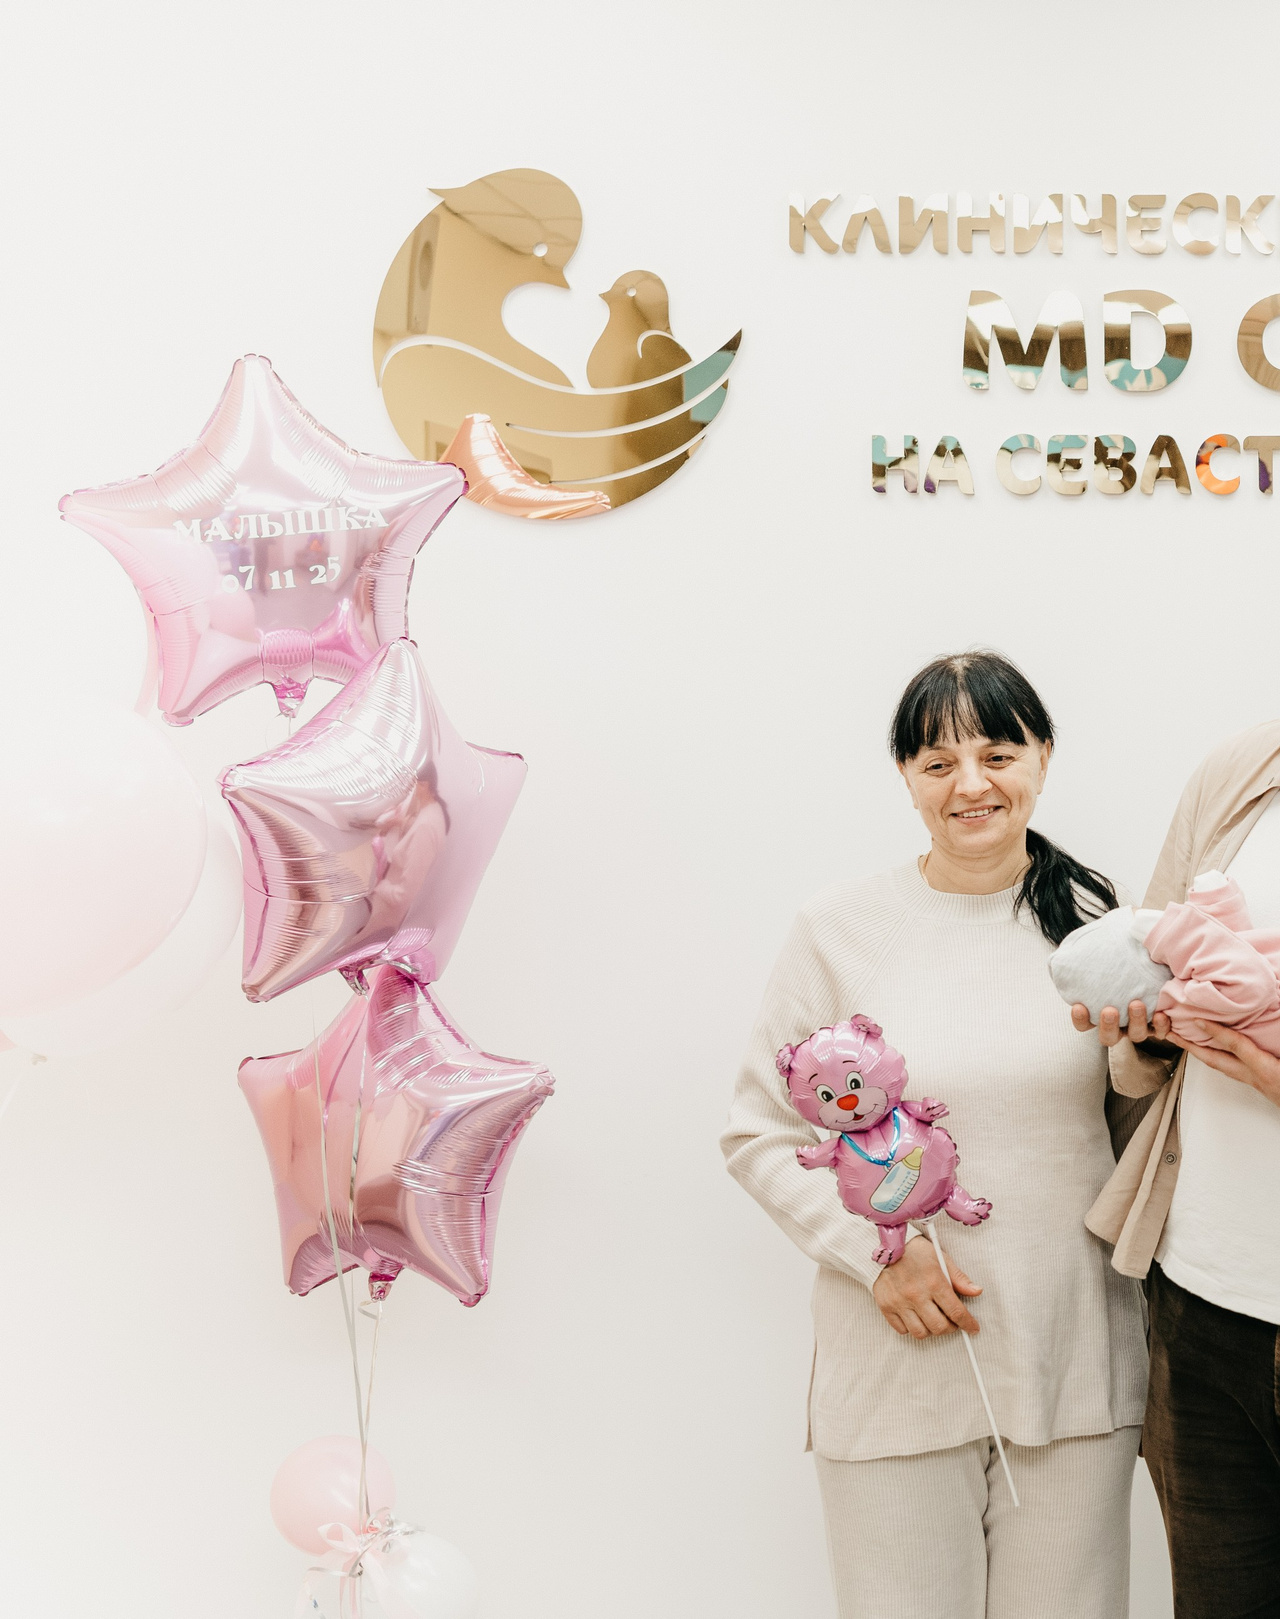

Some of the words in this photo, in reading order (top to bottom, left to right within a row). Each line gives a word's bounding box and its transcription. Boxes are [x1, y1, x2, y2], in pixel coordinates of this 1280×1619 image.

[961, 289, 1193, 392] MD
[871, 433, 974, 496] НА
[172, 505, 390, 545] МАЛЫШКА
[221, 565, 256, 594] 07
[269, 569, 297, 590] 11
[308, 556, 342, 585] 25
